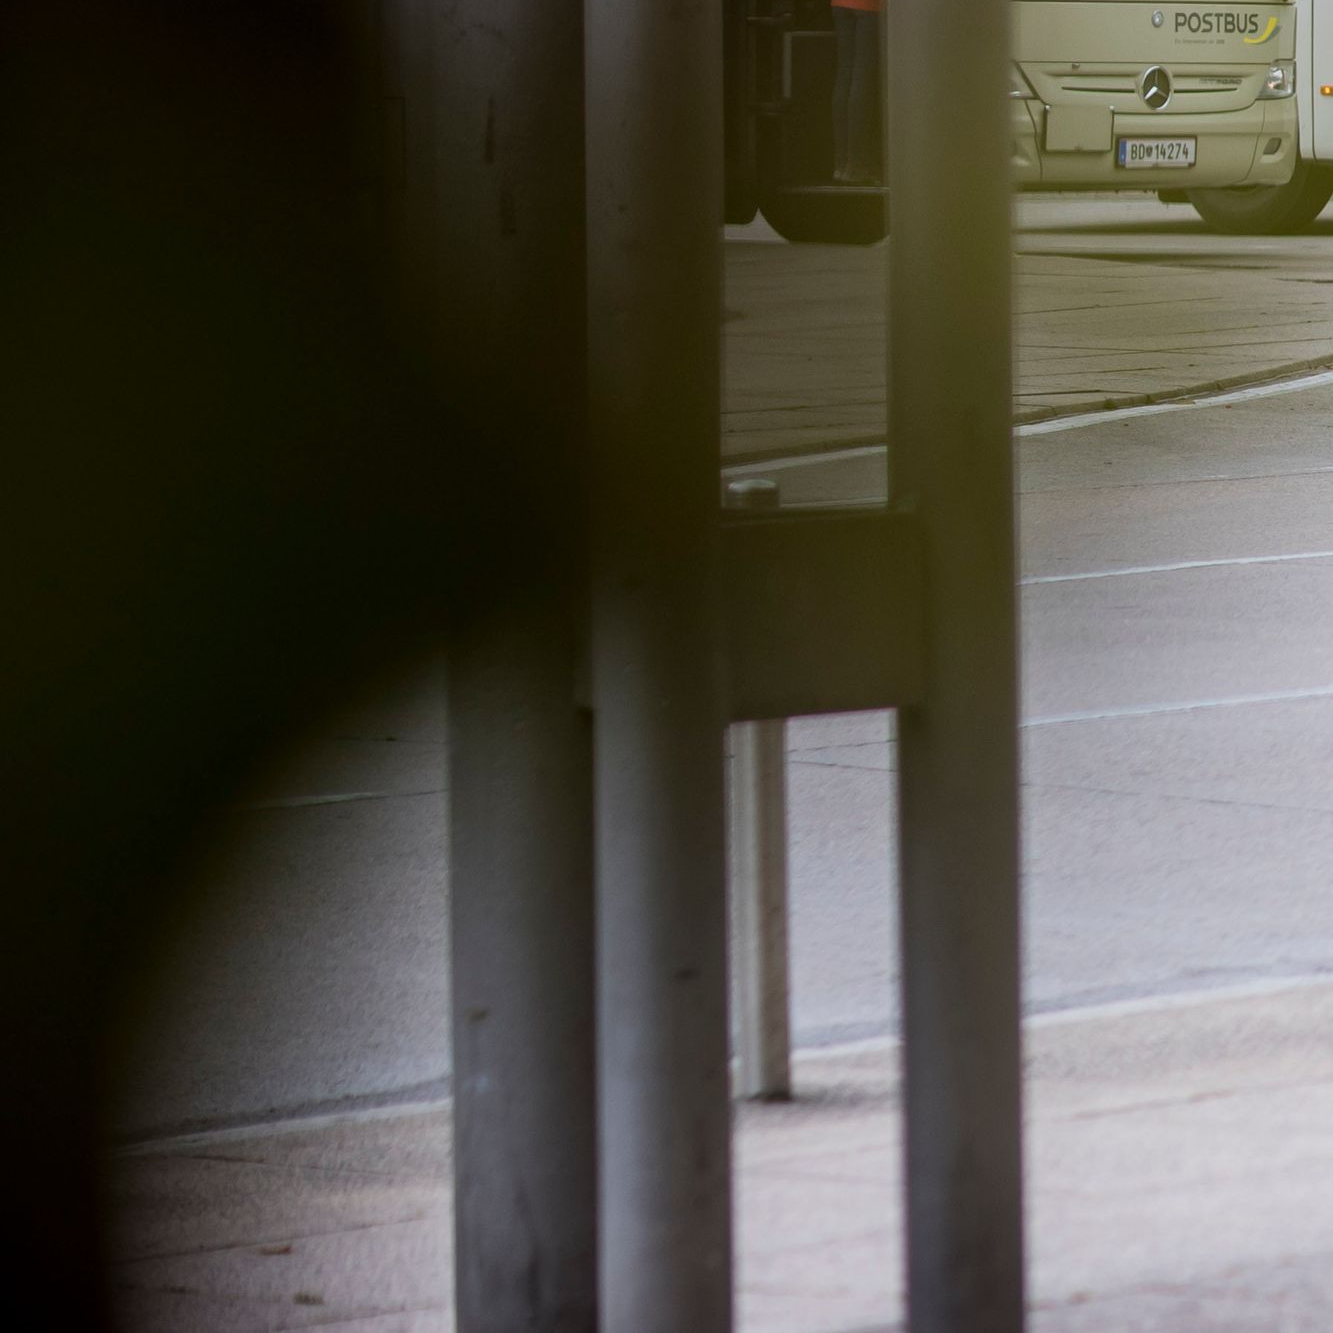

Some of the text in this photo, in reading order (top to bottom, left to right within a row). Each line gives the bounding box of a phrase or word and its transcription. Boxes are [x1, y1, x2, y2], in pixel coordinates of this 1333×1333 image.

[1174, 12, 1260, 34] POSTBUS
[1130, 142, 1189, 160] BD 14274
